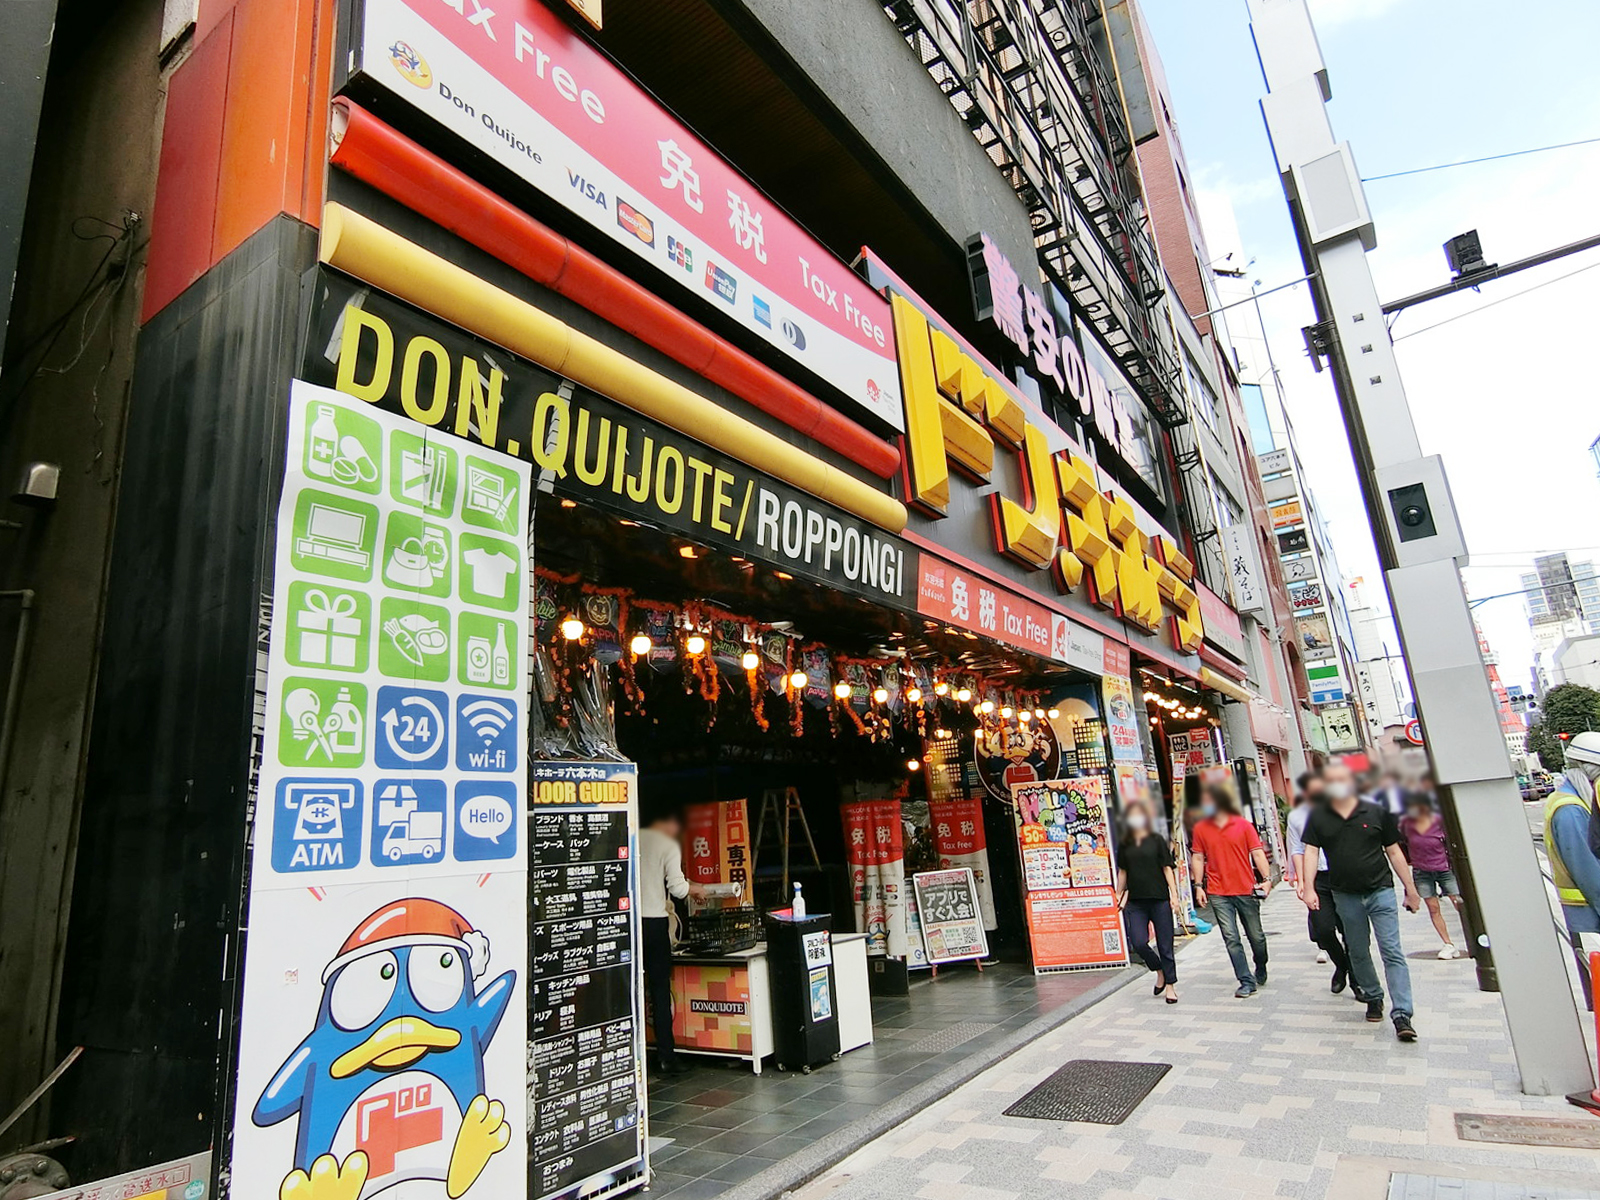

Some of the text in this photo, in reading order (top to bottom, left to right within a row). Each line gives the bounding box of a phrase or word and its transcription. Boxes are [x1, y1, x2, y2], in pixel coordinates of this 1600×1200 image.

[514, 21, 606, 124] Free
[438, 82, 543, 165] Don Quijote
[565, 165, 608, 210] VISA
[798, 256, 887, 349] Tax Free
[1002, 606, 1049, 646] Tax Free
[400, 716, 431, 742] 24
[469, 750, 506, 768] wi-fi
[579, 781, 628, 804] GUIDE
[1070, 790, 1087, 815] 2020
[469, 809, 505, 823] Hello
[535, 815, 564, 824] ブランド
[937, 821, 976, 838] 免税
[942, 840, 973, 850] Tax Free
[289, 843, 344, 867] ATM
[604, 864, 622, 873] ゲーム
[697, 865, 714, 876] Tax
[924, 890, 968, 907] アプリで
[692, 1001, 744, 1013] DONQUIJOTE
[549, 1063, 574, 1078] ドリンク
[543, 1156, 574, 1176] おつまみ
